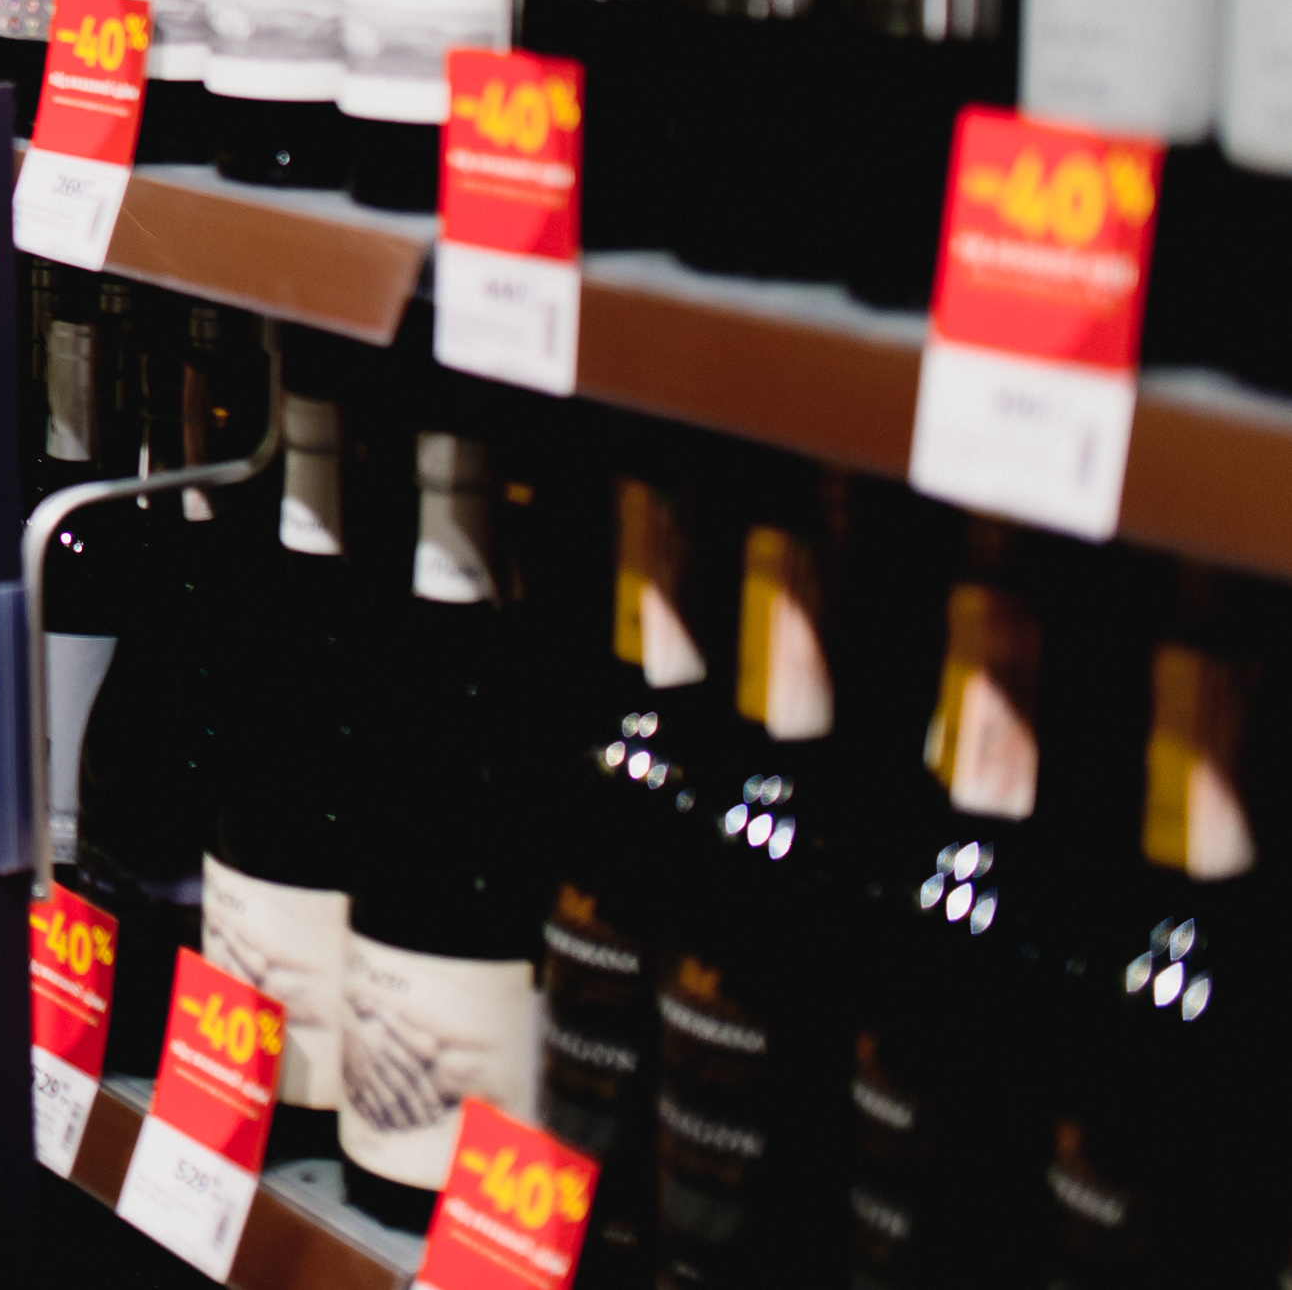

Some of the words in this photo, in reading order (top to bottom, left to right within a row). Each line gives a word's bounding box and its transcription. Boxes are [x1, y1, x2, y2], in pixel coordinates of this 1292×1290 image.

[56, 13, 150, 72] -40%
[450, 79, 581, 153] -40%
[962, 152, 1155, 248] -40%
[30, 912, 113, 975] -40%
[179, 994, 284, 1064] -40%
[175, 1156, 211, 1194] 529
[459, 1148, 588, 1229] -40%
